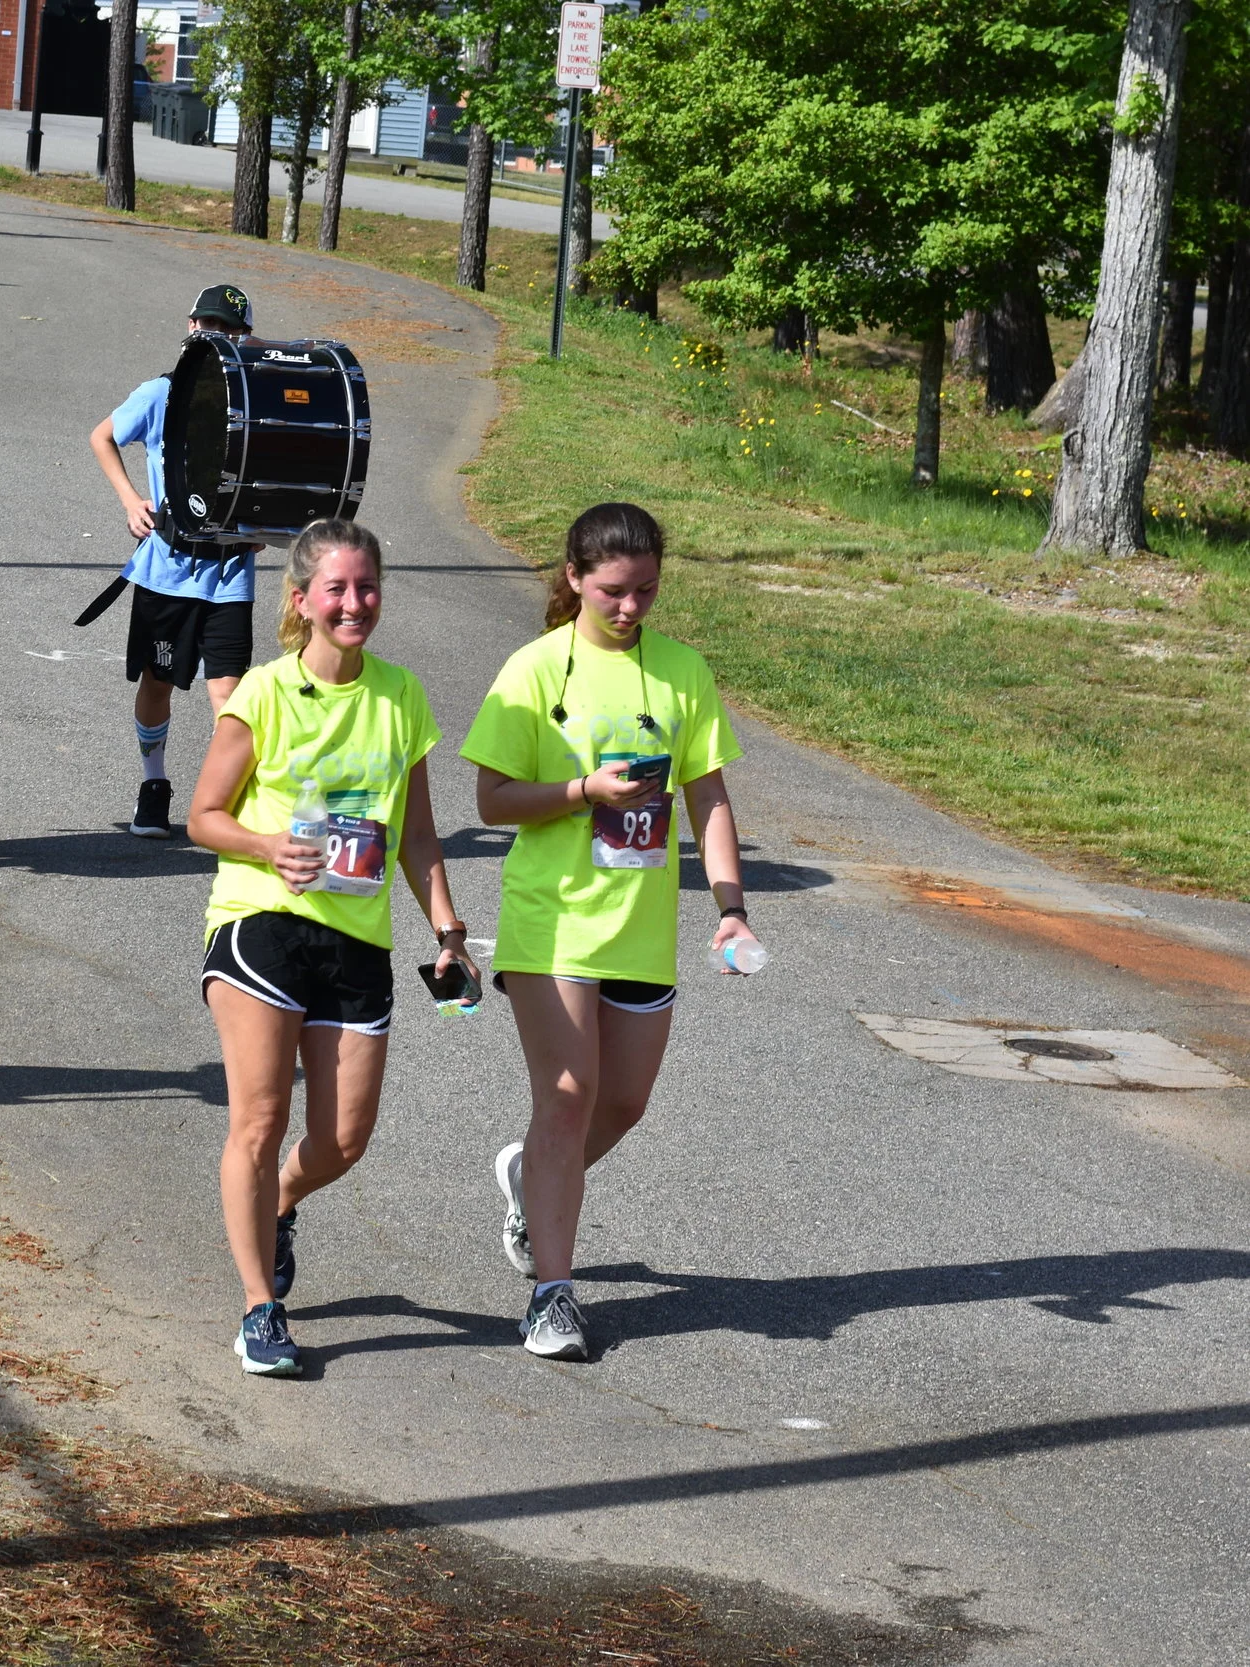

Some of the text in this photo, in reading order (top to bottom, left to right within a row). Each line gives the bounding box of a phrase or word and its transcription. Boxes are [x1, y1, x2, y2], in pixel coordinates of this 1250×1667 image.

[578, 10, 588, 18] NO
[567, 21, 596, 30] PARKING
[573, 32, 588, 41] FIRE
[570, 44, 589, 53] LANE
[567, 55, 592, 64] TOWING
[560, 66, 596, 76] ENFORCED
[262, 350, 312, 364] Pearl
[623, 811, 652, 846] 93
[326, 834, 359, 872] 91
